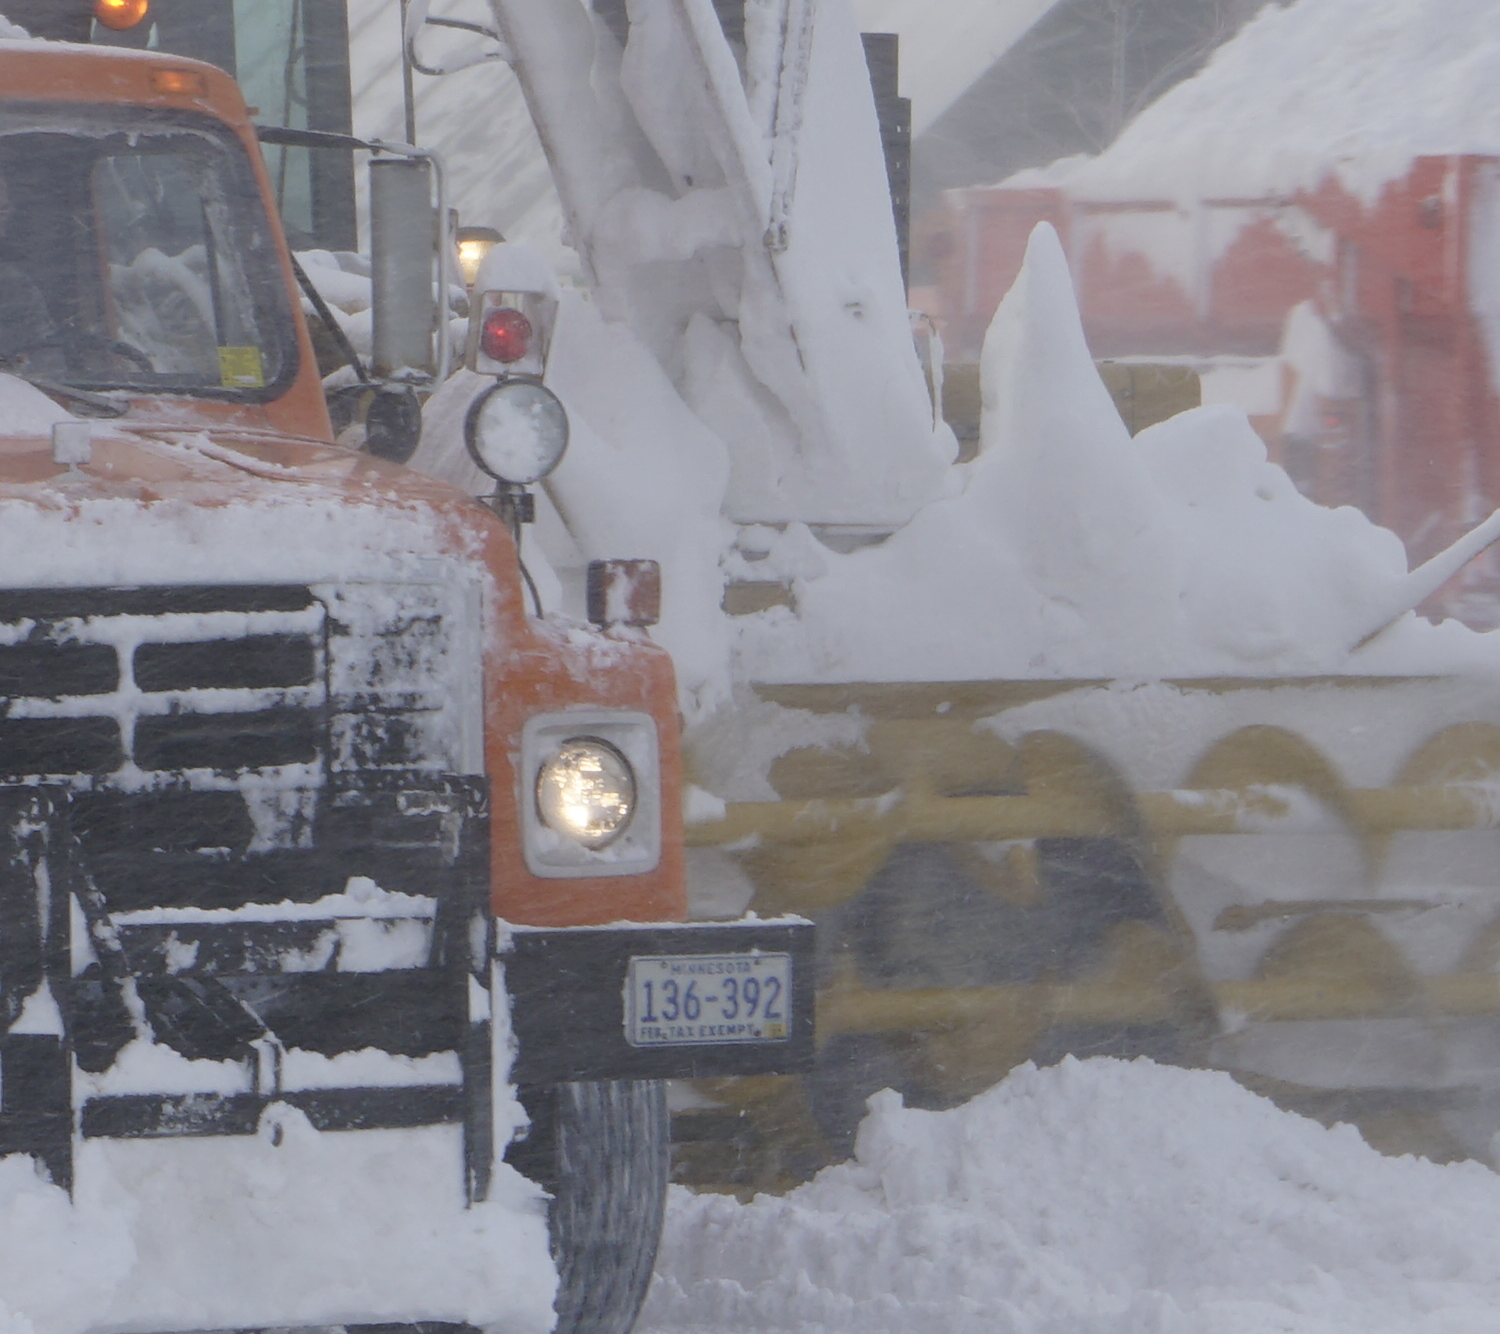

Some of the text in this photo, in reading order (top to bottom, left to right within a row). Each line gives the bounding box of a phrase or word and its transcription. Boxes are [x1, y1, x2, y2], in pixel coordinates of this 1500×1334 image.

[670, 961, 751, 975] MINNESOTA
[640, 976, 783, 1023] 136-392
[667, 1024, 695, 1038] TAX
[698, 1023, 755, 1037] EXEMPT
